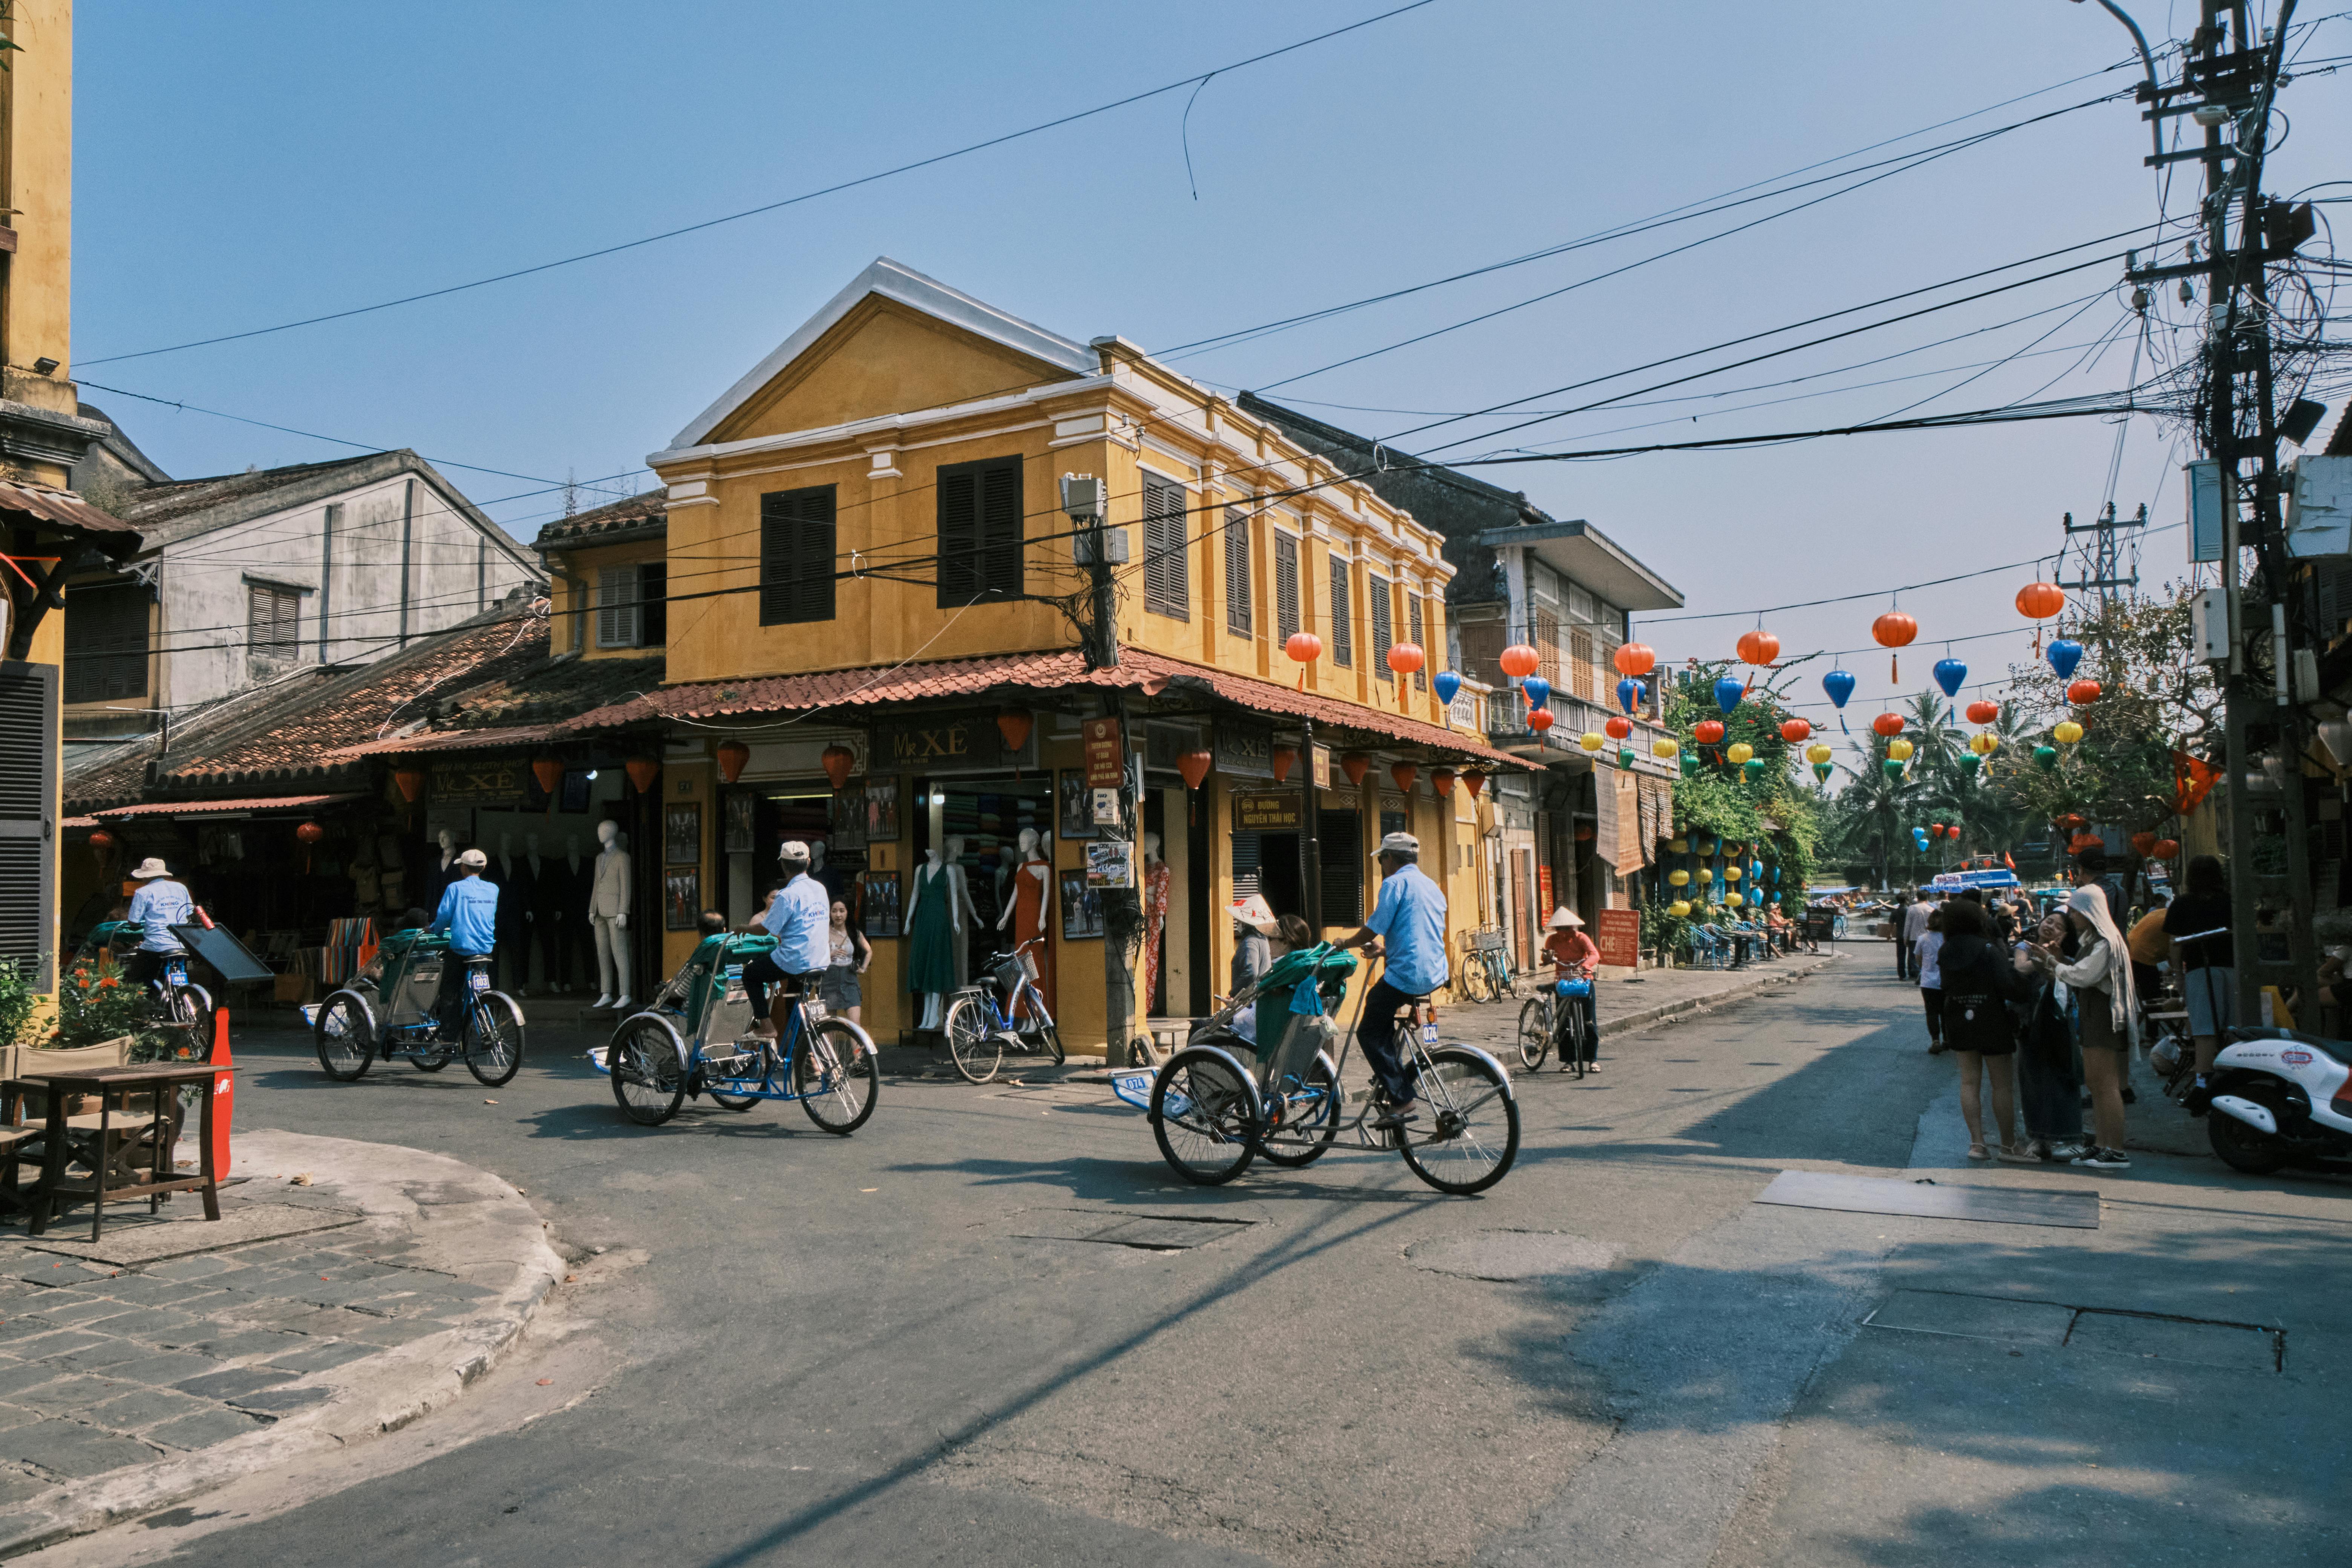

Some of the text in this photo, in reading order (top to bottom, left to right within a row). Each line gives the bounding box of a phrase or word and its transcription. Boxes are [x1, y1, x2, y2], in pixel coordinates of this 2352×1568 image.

[1257, 799, 1279, 810] ĐƯỜNG
[1268, 812, 1282, 823] THÁI
[1283, 813, 1295, 824] HỌC
[475, 977, 487, 986] 103
[1424, 1026, 1438, 1041] 074
[1128, 1078, 1143, 1089] 074
